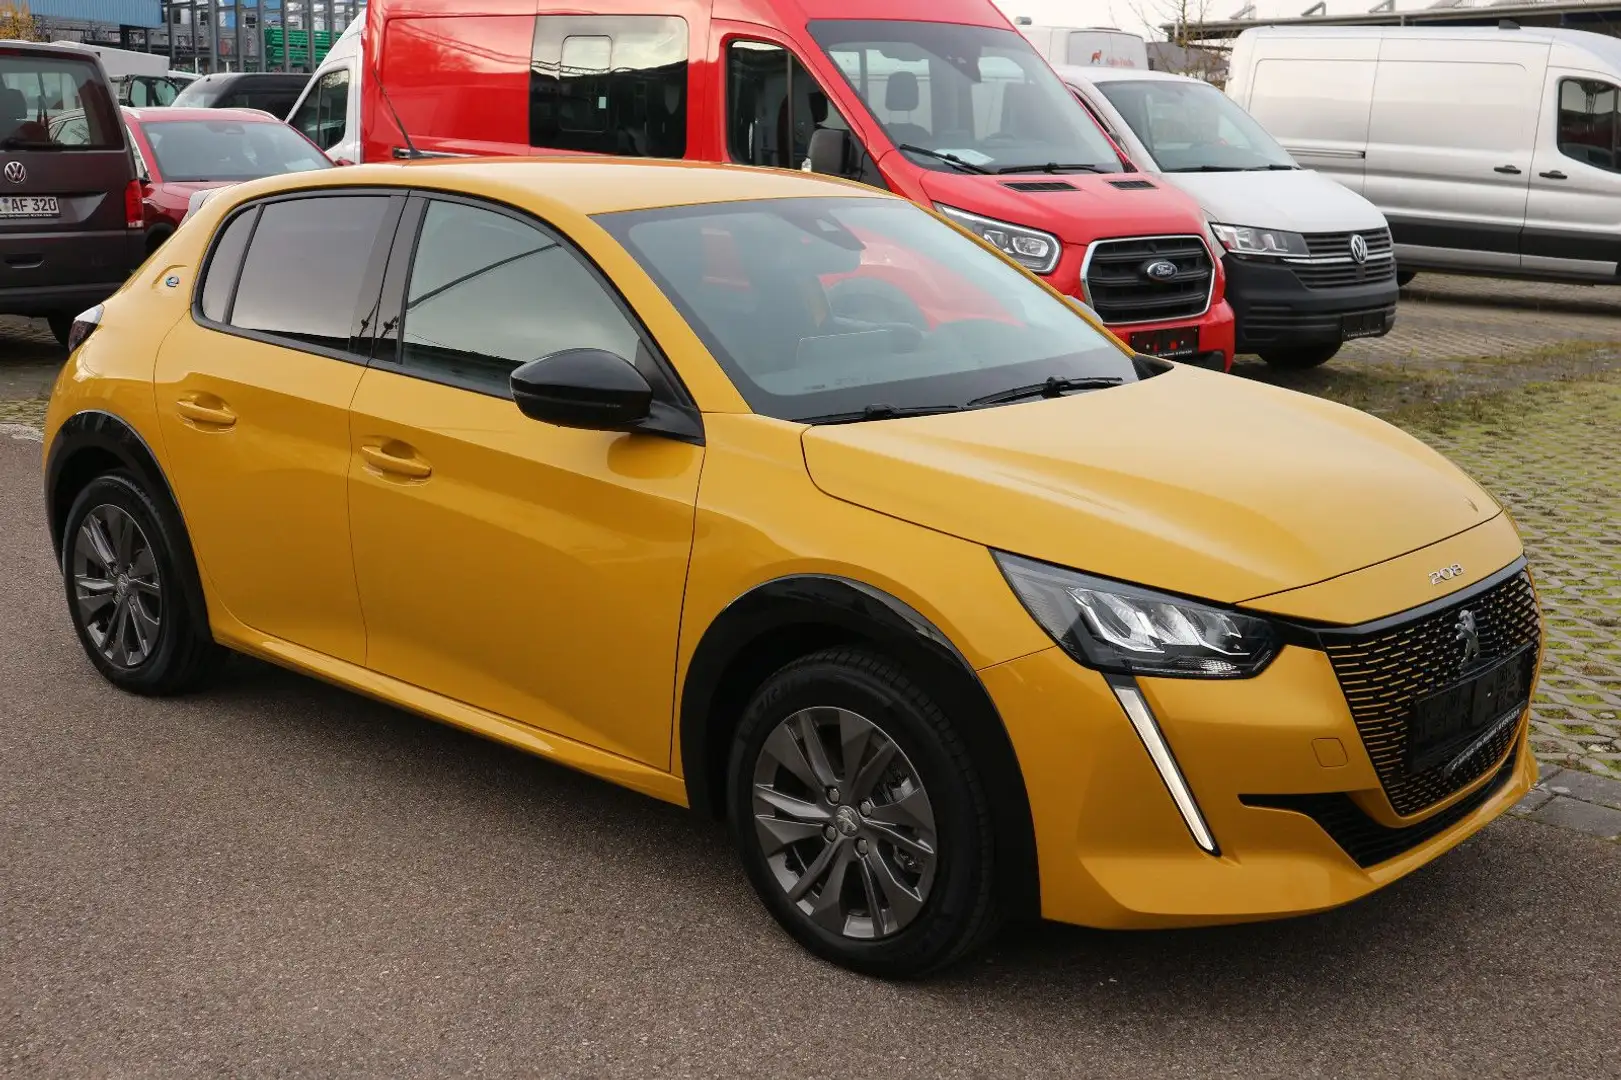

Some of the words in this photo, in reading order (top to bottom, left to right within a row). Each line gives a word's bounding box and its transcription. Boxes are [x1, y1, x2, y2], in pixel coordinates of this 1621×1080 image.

[11, 198, 28, 212] AF
[31, 198, 58, 212] 320
[1428, 563, 1464, 585] 208
